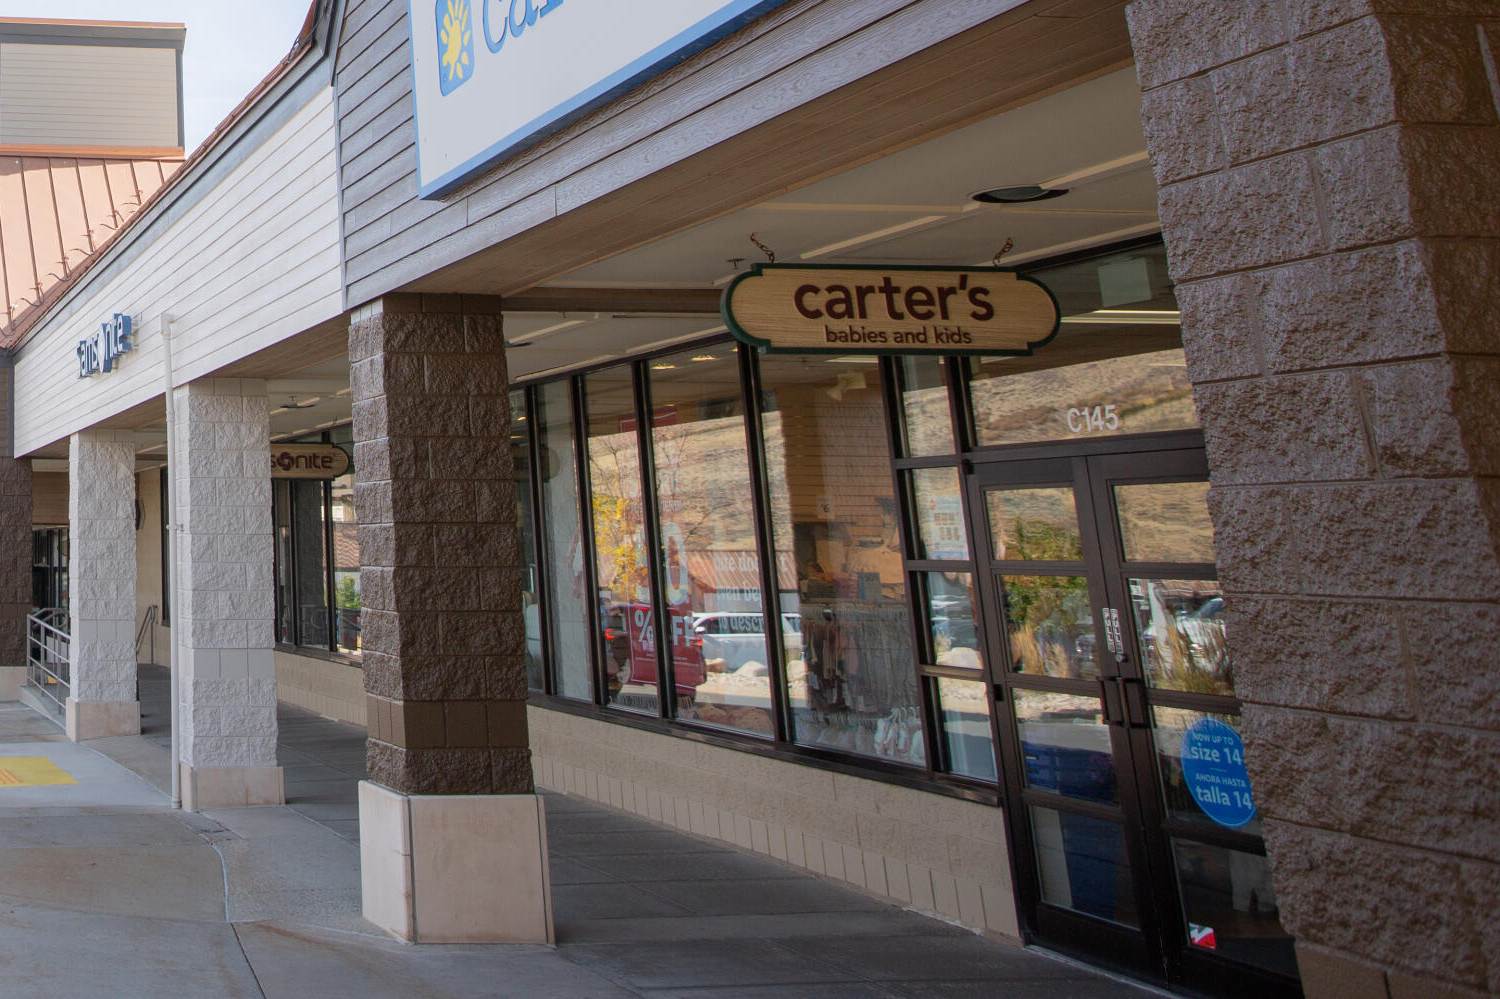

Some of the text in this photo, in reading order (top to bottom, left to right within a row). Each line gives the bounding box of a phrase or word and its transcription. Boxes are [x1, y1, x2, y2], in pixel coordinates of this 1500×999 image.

[794, 273, 995, 321] carter's
[824, 325, 973, 345] babies and kids
[1067, 404, 1119, 433] C145
[270, 451, 333, 471] sonite
[1192, 732, 1234, 746] NOW UP TO
[1190, 743, 1242, 766] size 14
[1195, 773, 1247, 788] AHORA HASTA
[1195, 785, 1252, 810] talla 14
